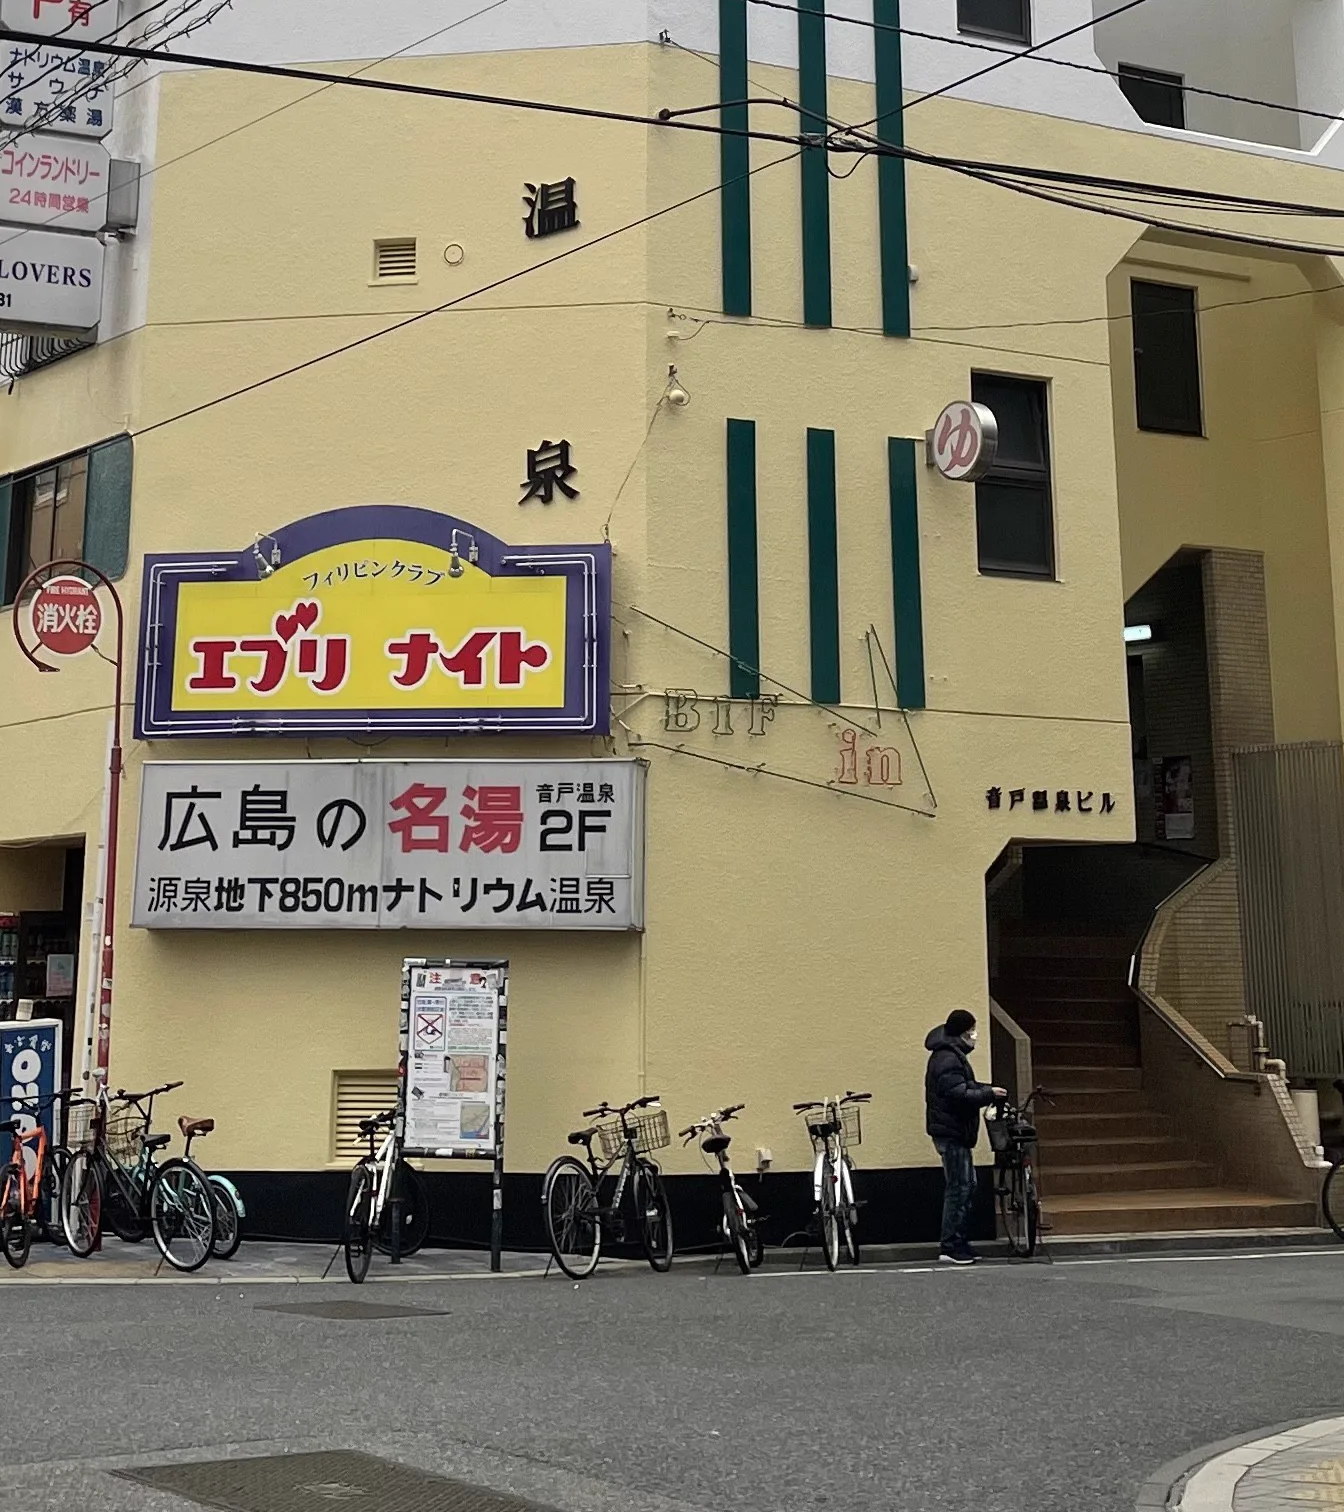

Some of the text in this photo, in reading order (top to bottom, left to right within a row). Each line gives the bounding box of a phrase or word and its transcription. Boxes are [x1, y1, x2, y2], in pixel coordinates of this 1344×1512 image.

[1, 149, 101, 185] コインランドリー
[9, 188, 89, 214] 24時間営業
[938, 408, 978, 472] ゆ
[302, 559, 446, 591] フィリピンクラブ
[36, 603, 97, 634] 消火栓
[189, 602, 550, 693] エブリ ナイト
[535, 782, 616, 804] 音戸温泉
[985, 786, 1116, 815] 音戸温泉ビル
[157, 783, 525, 854] 広島の名湯
[539, 809, 613, 852] 2F
[147, 875, 617, 915] 源泉地下850mナトリウム温泉
